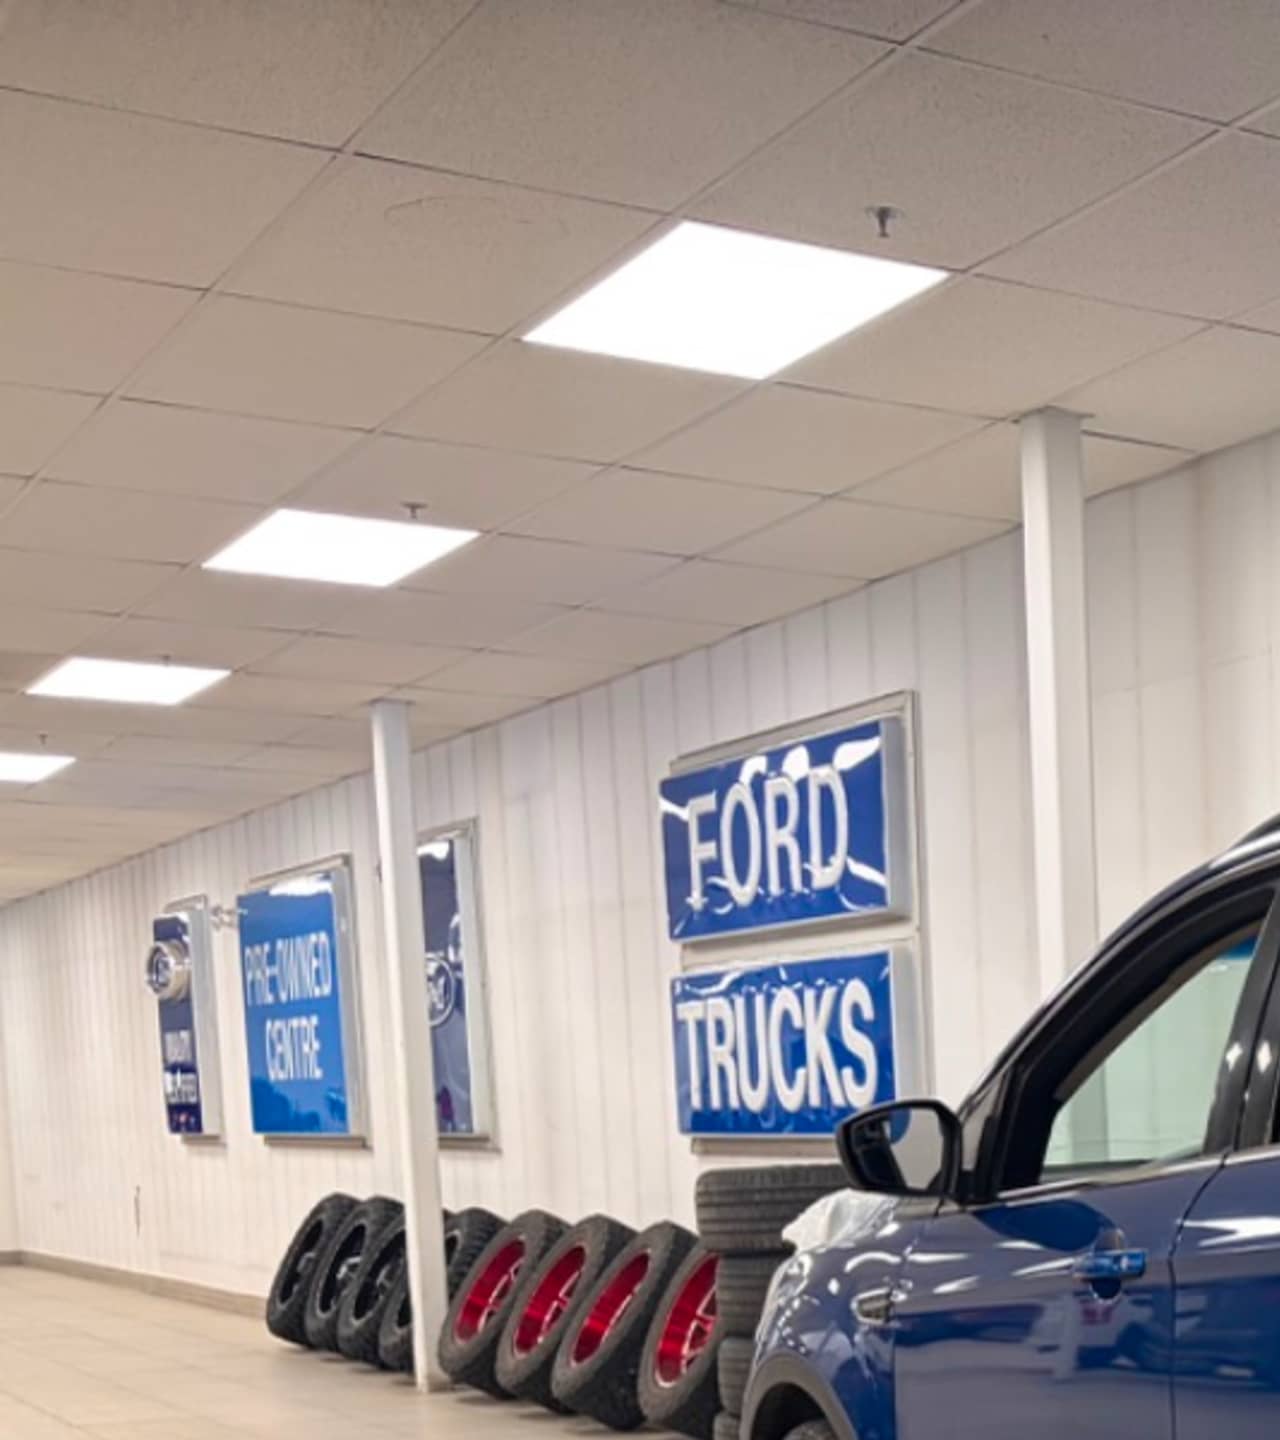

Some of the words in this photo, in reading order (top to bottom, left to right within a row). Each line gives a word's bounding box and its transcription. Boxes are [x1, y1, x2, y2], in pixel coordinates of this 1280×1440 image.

[686, 767, 848, 910] FORD
[244, 932, 332, 1005] PRE-OWNED
[265, 1016, 323, 1081] CENTRE
[676, 976, 880, 1113] TRUCKS
